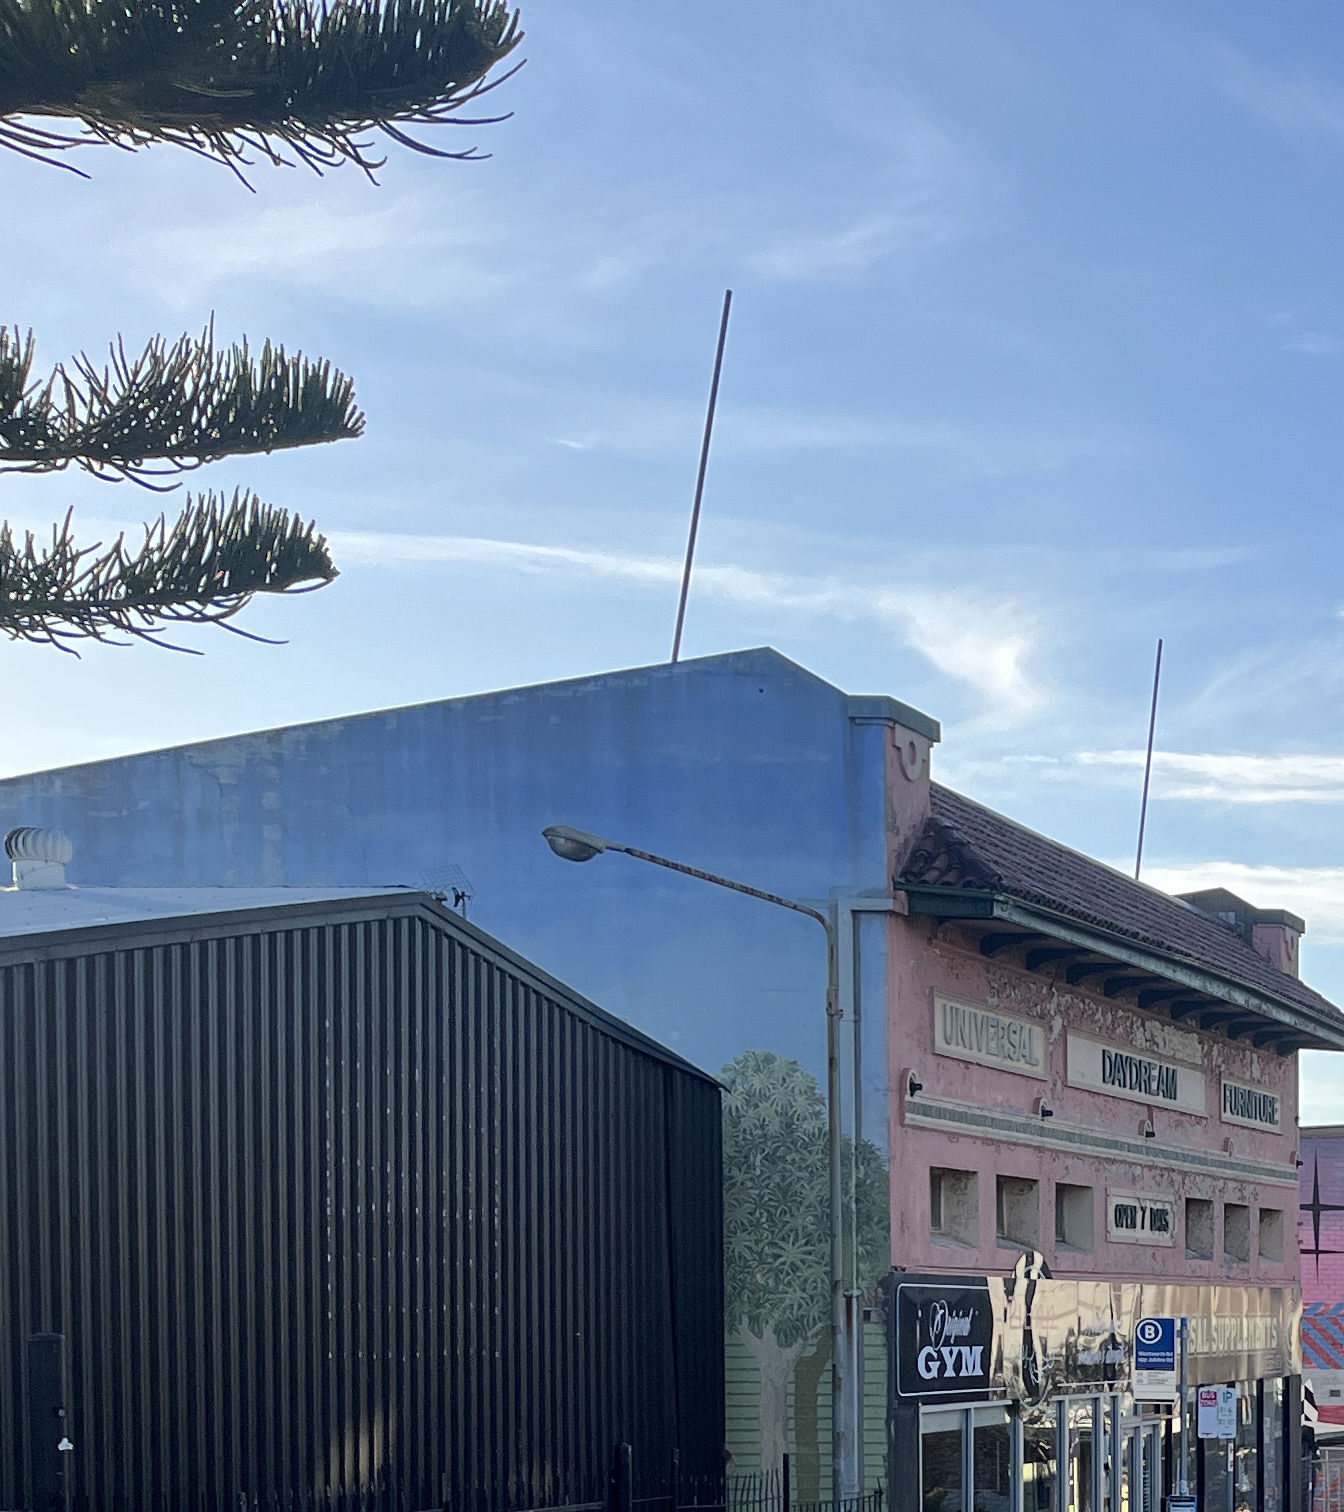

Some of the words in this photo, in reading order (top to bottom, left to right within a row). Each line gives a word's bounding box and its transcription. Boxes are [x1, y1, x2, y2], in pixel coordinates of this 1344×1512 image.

[943, 1003, 1040, 1067] UNIVERSAL
[1102, 1049, 1177, 1101] DAYDREAM
[1223, 1083, 1279, 1125] FURNITURE
[1115, 1204, 1136, 1229] OPEN
[1211, 1316, 1278, 1352] SUPPLEMENTS
[917, 1345, 984, 1380] GYM
